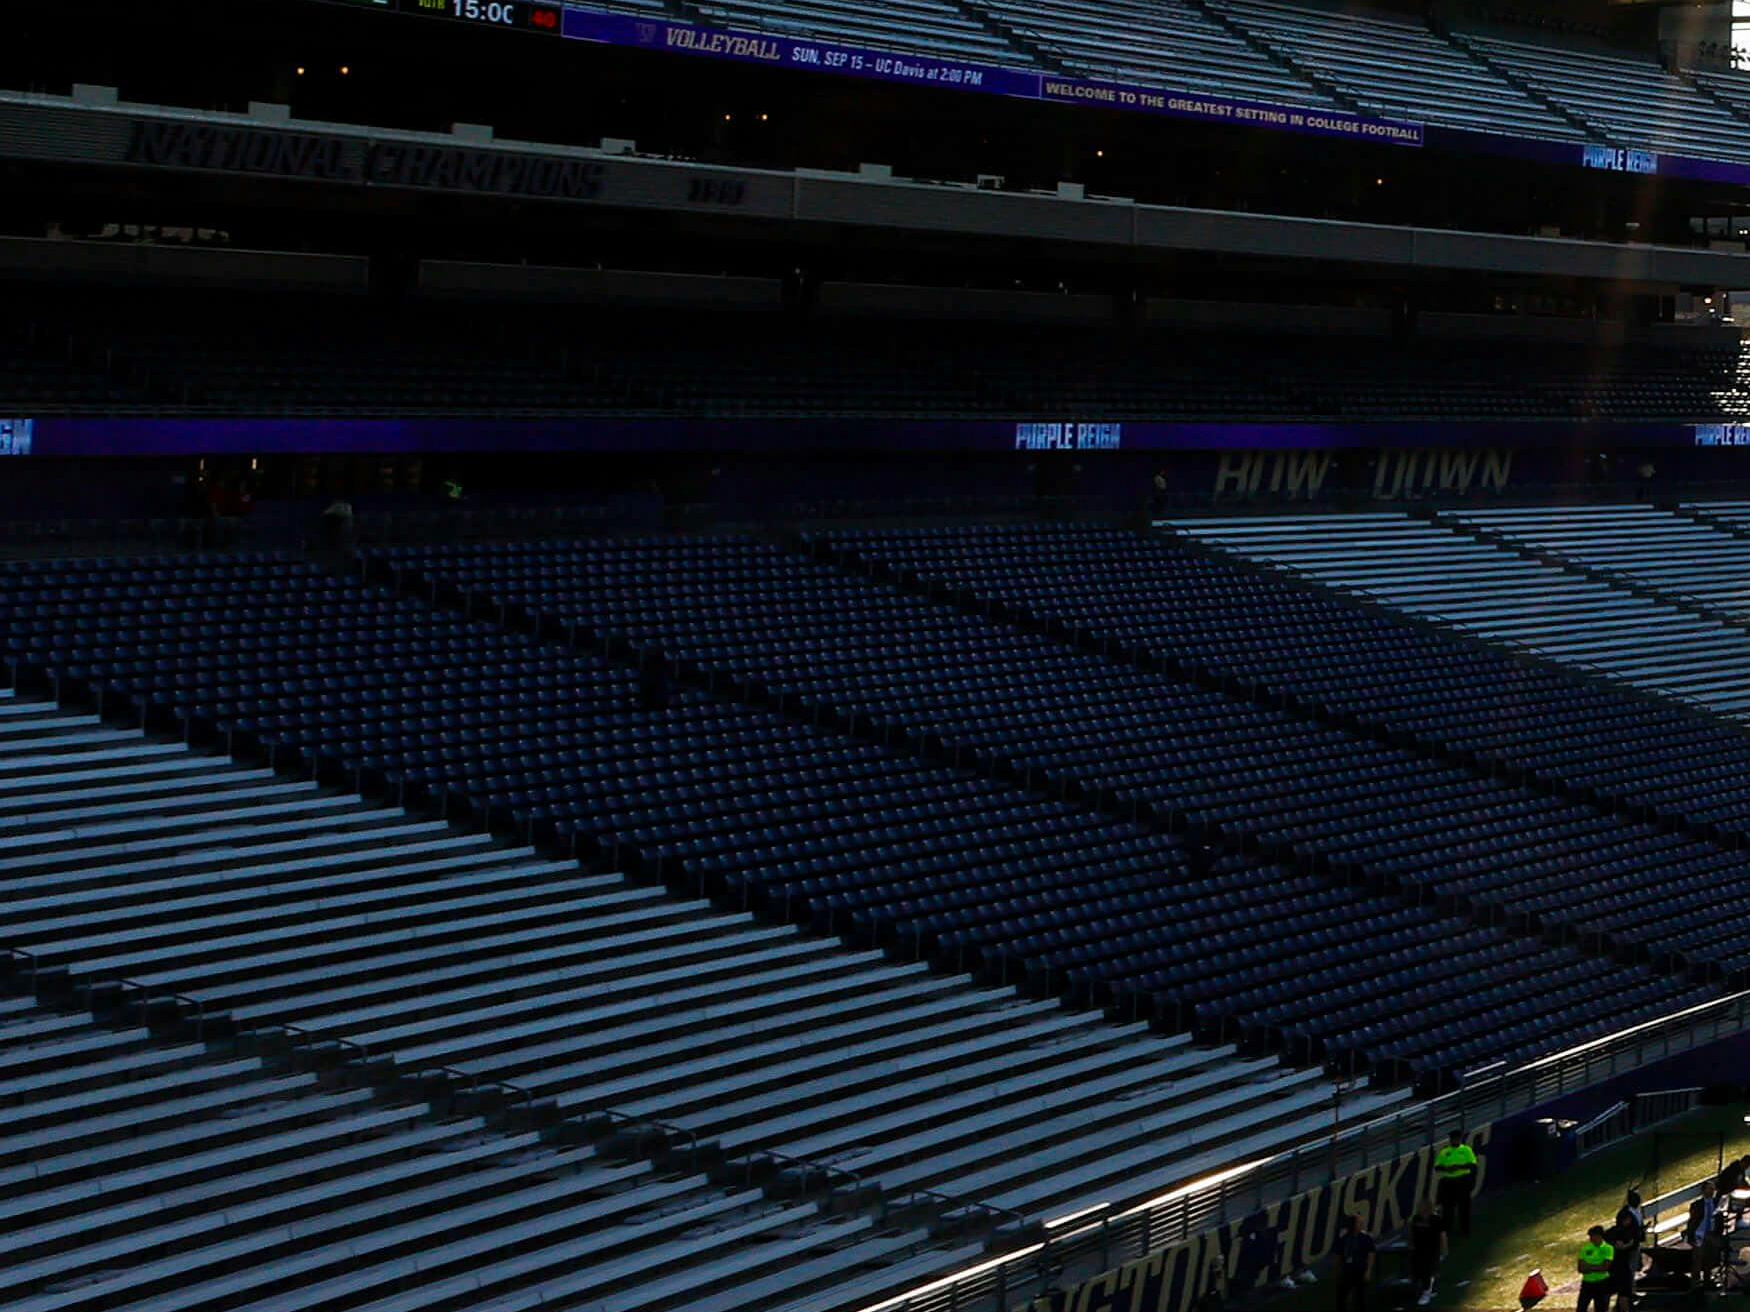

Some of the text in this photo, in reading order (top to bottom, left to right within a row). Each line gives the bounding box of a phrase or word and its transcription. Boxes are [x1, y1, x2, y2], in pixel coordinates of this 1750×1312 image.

[666, 26, 780, 61] VOLLEYBALL
[791, 46, 822, 66] SUN,
[823, 50, 848, 68] SEP
[850, 54, 864, 70] 15
[875, 58, 893, 74] UC
[893, 61, 926, 80] Davis
[926, 67, 939, 80] at
[939, 67, 963, 84] 2:00
[963, 71, 984, 87] PM
[1045, 82, 1420, 142] WELCOME TO THE GREATEST SETTING IN COLLEGE FOOTBALL
[128, 118, 600, 200] NATIONAL CHAMPIONS
[1583, 145, 1625, 171] PURPLE
[1015, 422, 1124, 450] PURPLE REIGN
[1695, 425, 1735, 446] PURPLE
